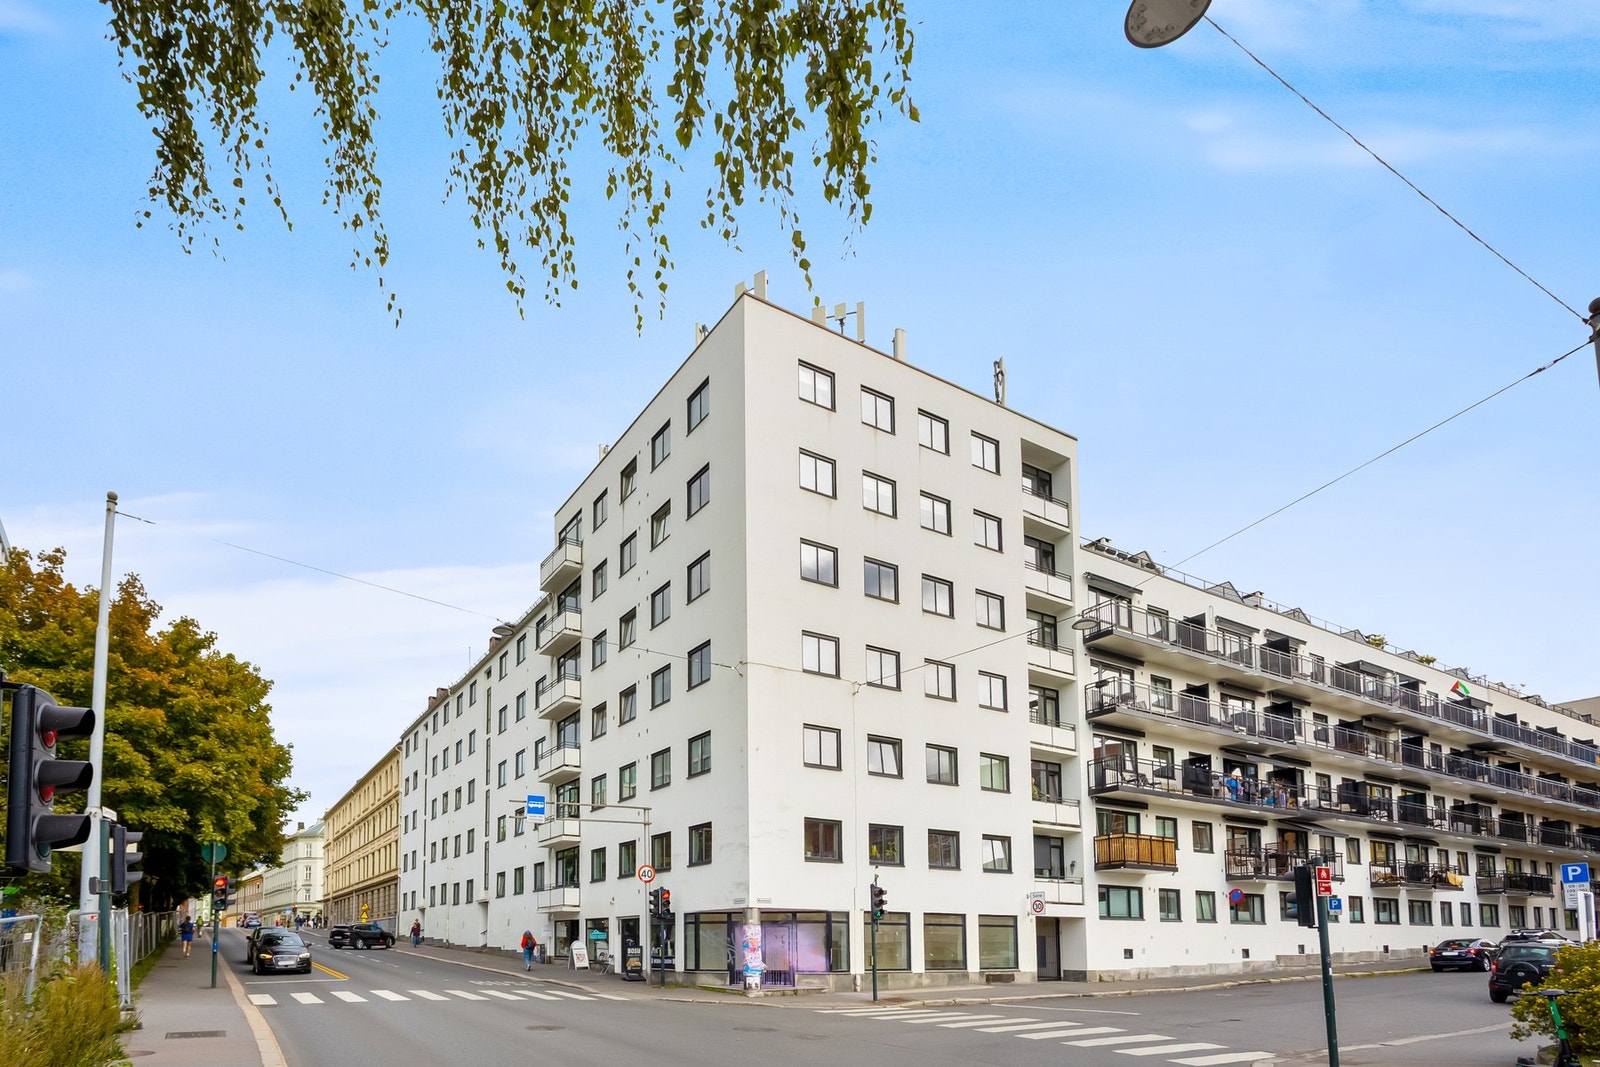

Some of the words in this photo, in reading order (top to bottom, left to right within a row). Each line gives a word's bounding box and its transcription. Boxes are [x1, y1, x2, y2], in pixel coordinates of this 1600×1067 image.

[641, 869, 652, 878] 40
[1567, 866, 1582, 881] P
[1332, 900, 1338, 908] P
